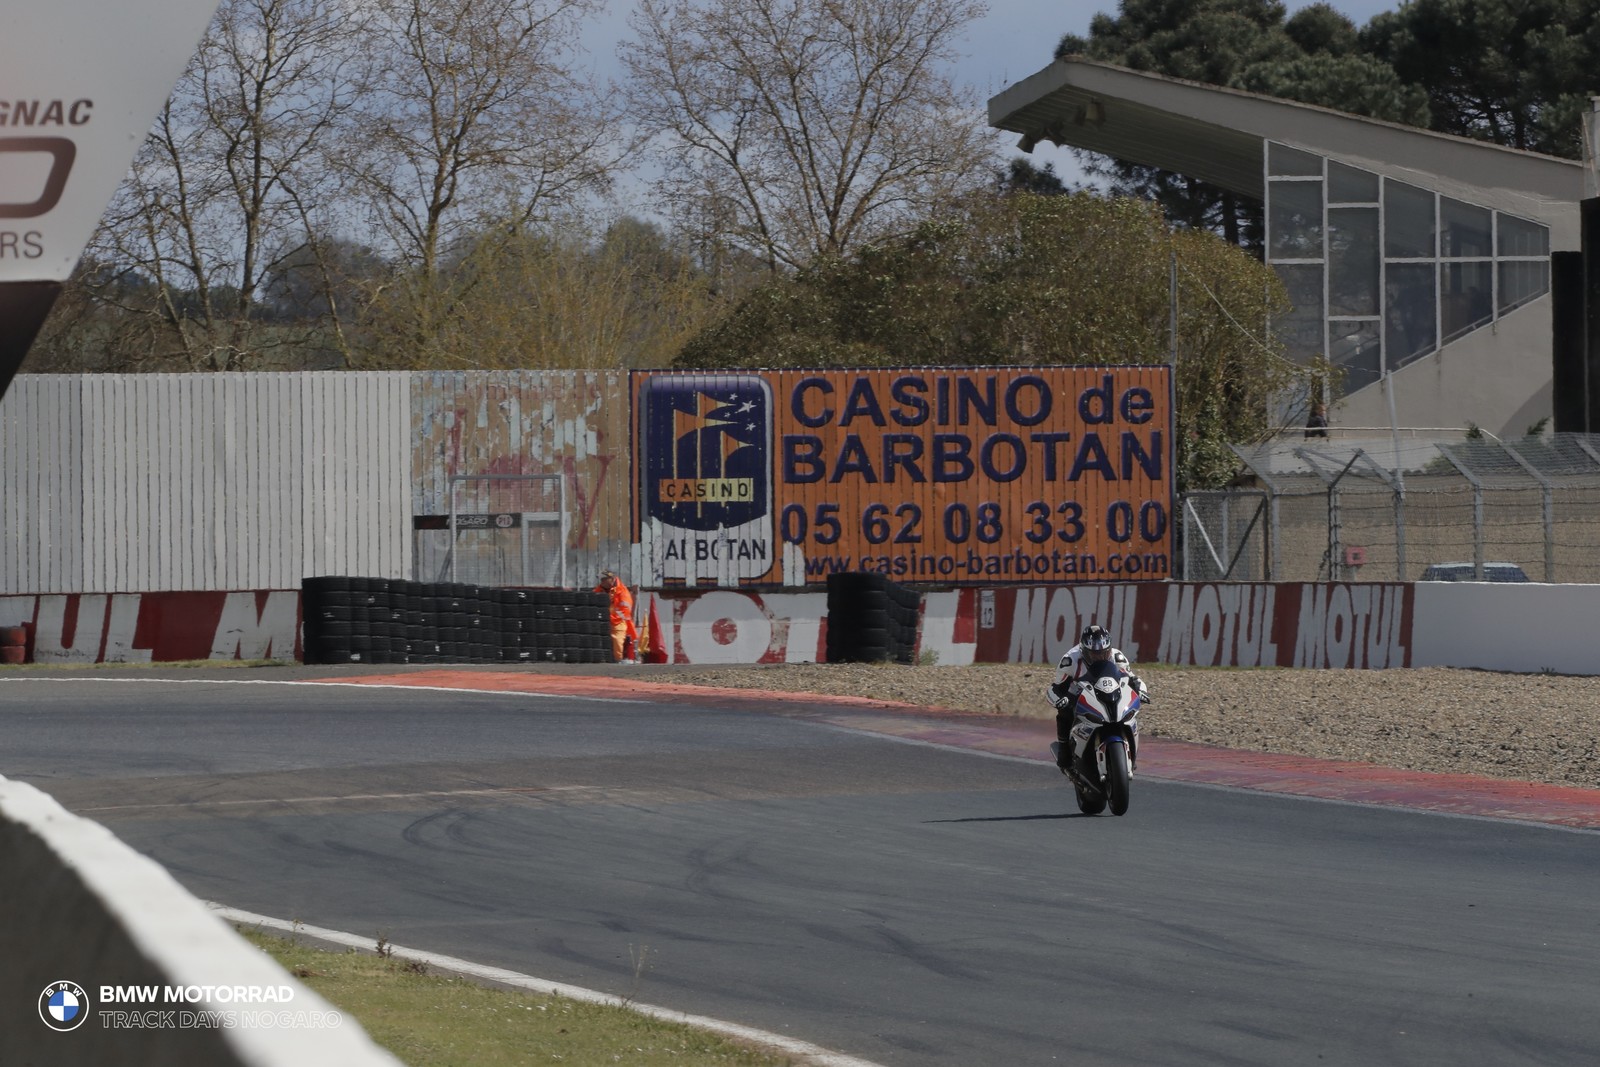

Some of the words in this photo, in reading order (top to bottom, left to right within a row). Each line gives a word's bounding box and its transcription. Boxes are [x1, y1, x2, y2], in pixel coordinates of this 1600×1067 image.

[791, 376, 1053, 427] CASINO
[1078, 374, 1155, 425] de
[782, 431, 1162, 484] BARBOTAN
[666, 482, 749, 498] CASINO
[781, 502, 841, 546] 05
[862, 502, 922, 545] 62
[943, 502, 1003, 544] 08
[1025, 501, 1085, 544] 33
[1106, 501, 1167, 543] 00
[780, 548, 1168, 577] ww.casino-barbotan.com
[1157, 584, 1277, 667] MOTUL
[1293, 583, 1405, 669] MOTUL
